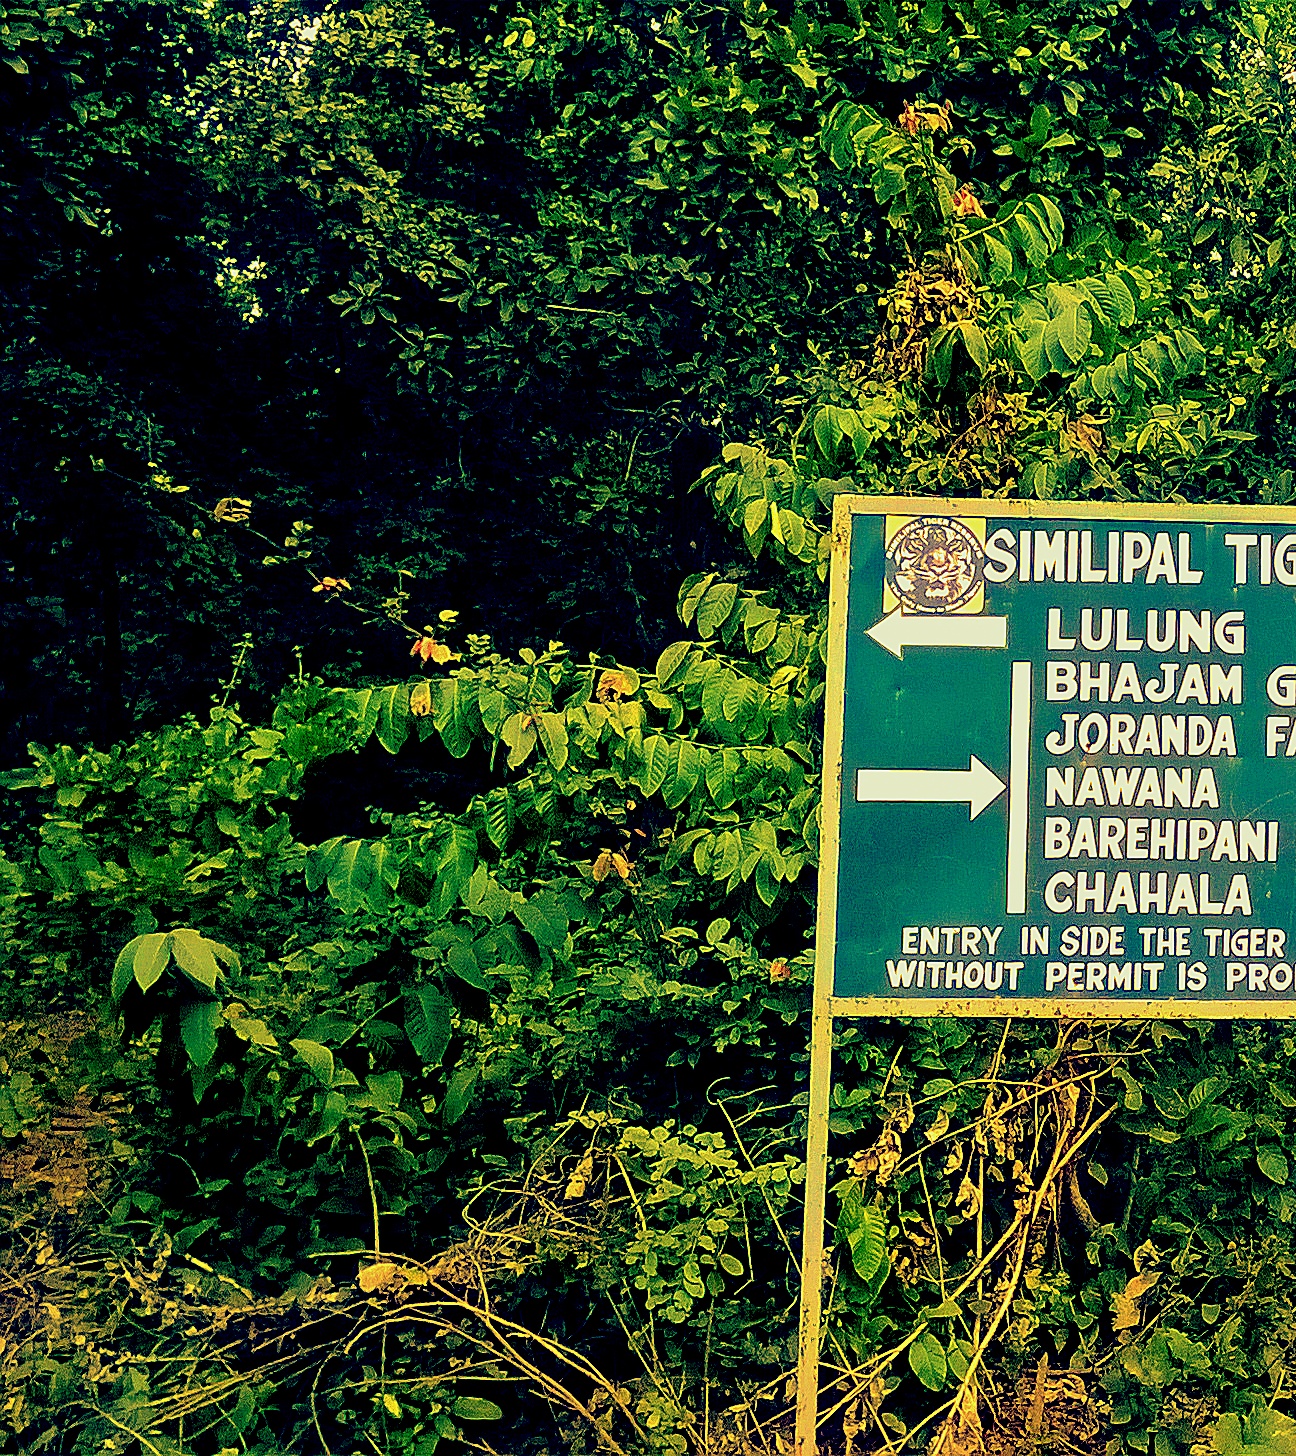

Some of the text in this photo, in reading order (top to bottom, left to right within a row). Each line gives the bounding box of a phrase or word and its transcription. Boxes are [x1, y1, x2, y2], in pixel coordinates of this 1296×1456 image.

[982, 528, 1204, 584] SIMILIPAL
[1047, 608, 1245, 654] LULUNG
[1046, 660, 1242, 705] BHAJAM
[1045, 712, 1237, 756] JORANDA
[1045, 766, 1220, 809] NAWANA
[1044, 816, 1279, 863] BAREHIPANI
[1044, 871, 1252, 916] CHAHALA
[901, 926, 1004, 956] ENTRY
[1021, 926, 1049, 955] IN
[1059, 925, 1125, 956] SIDE
[1138, 927, 1191, 957] THE
[1203, 928, 1286, 958] TIGER
[886, 959, 1025, 991] WITHOUT
[1045, 961, 1165, 992] PERMIT
[1178, 961, 1208, 991] IS
